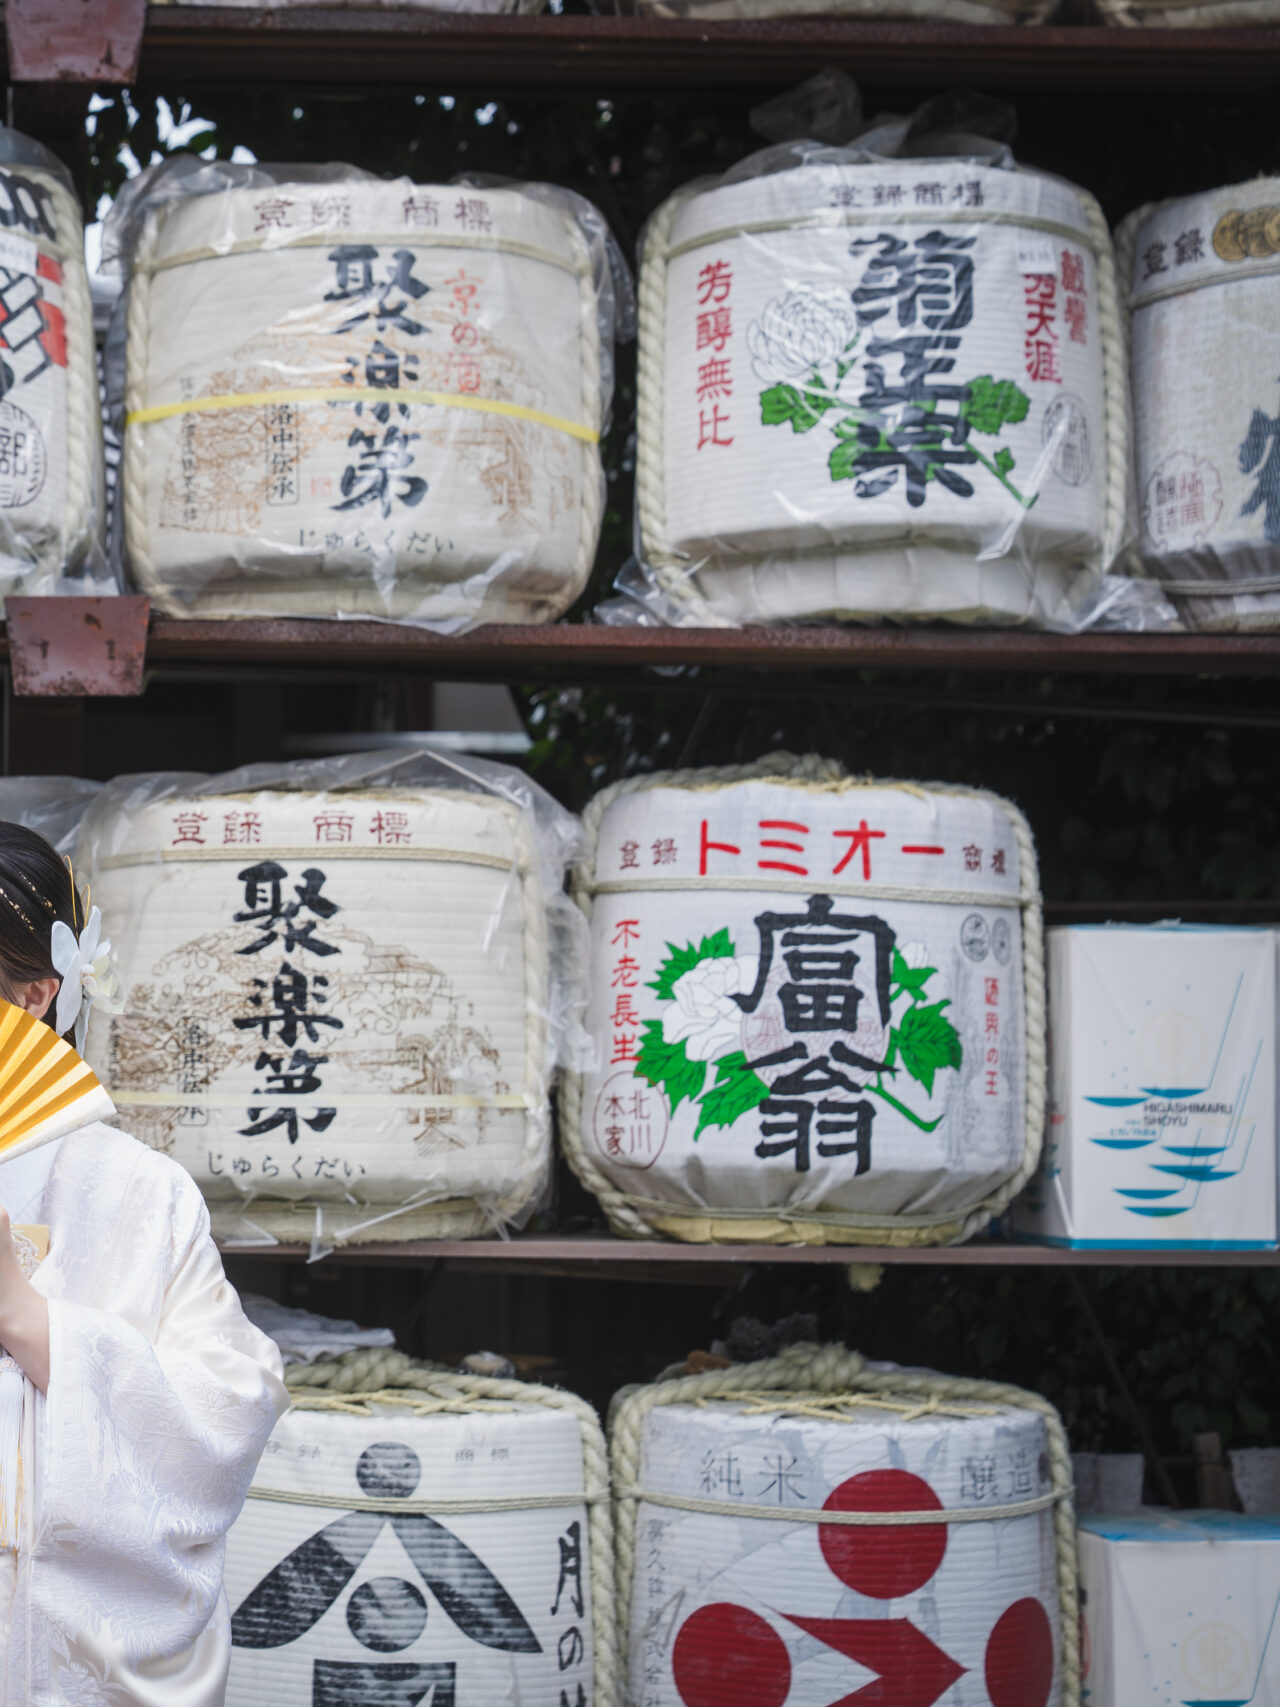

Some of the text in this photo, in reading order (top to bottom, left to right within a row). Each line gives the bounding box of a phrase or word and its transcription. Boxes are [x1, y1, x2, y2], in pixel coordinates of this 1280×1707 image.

[443, 268, 485, 393] 京の酒
[696, 260, 735, 451] 芳醇無比
[271, 403, 294, 499] 洛中伝承
[171, 809, 414, 847] 登録 商標
[698, 819, 946, 880] トミオー
[232, 860, 345, 1145] 聚楽第
[610, 919, 643, 1064] 不老長生
[727, 893, 901, 1176] 富翁
[604, 1092, 626, 1156] 本家
[627, 1089, 651, 1154] 北川
[1143, 1102, 1233, 1115] HIGASHIMARU
[1143, 1115, 1188, 1127] SHOYU
[206, 1149, 367, 1180] じゅらくだい
[699, 1449, 807, 1503] 純米
